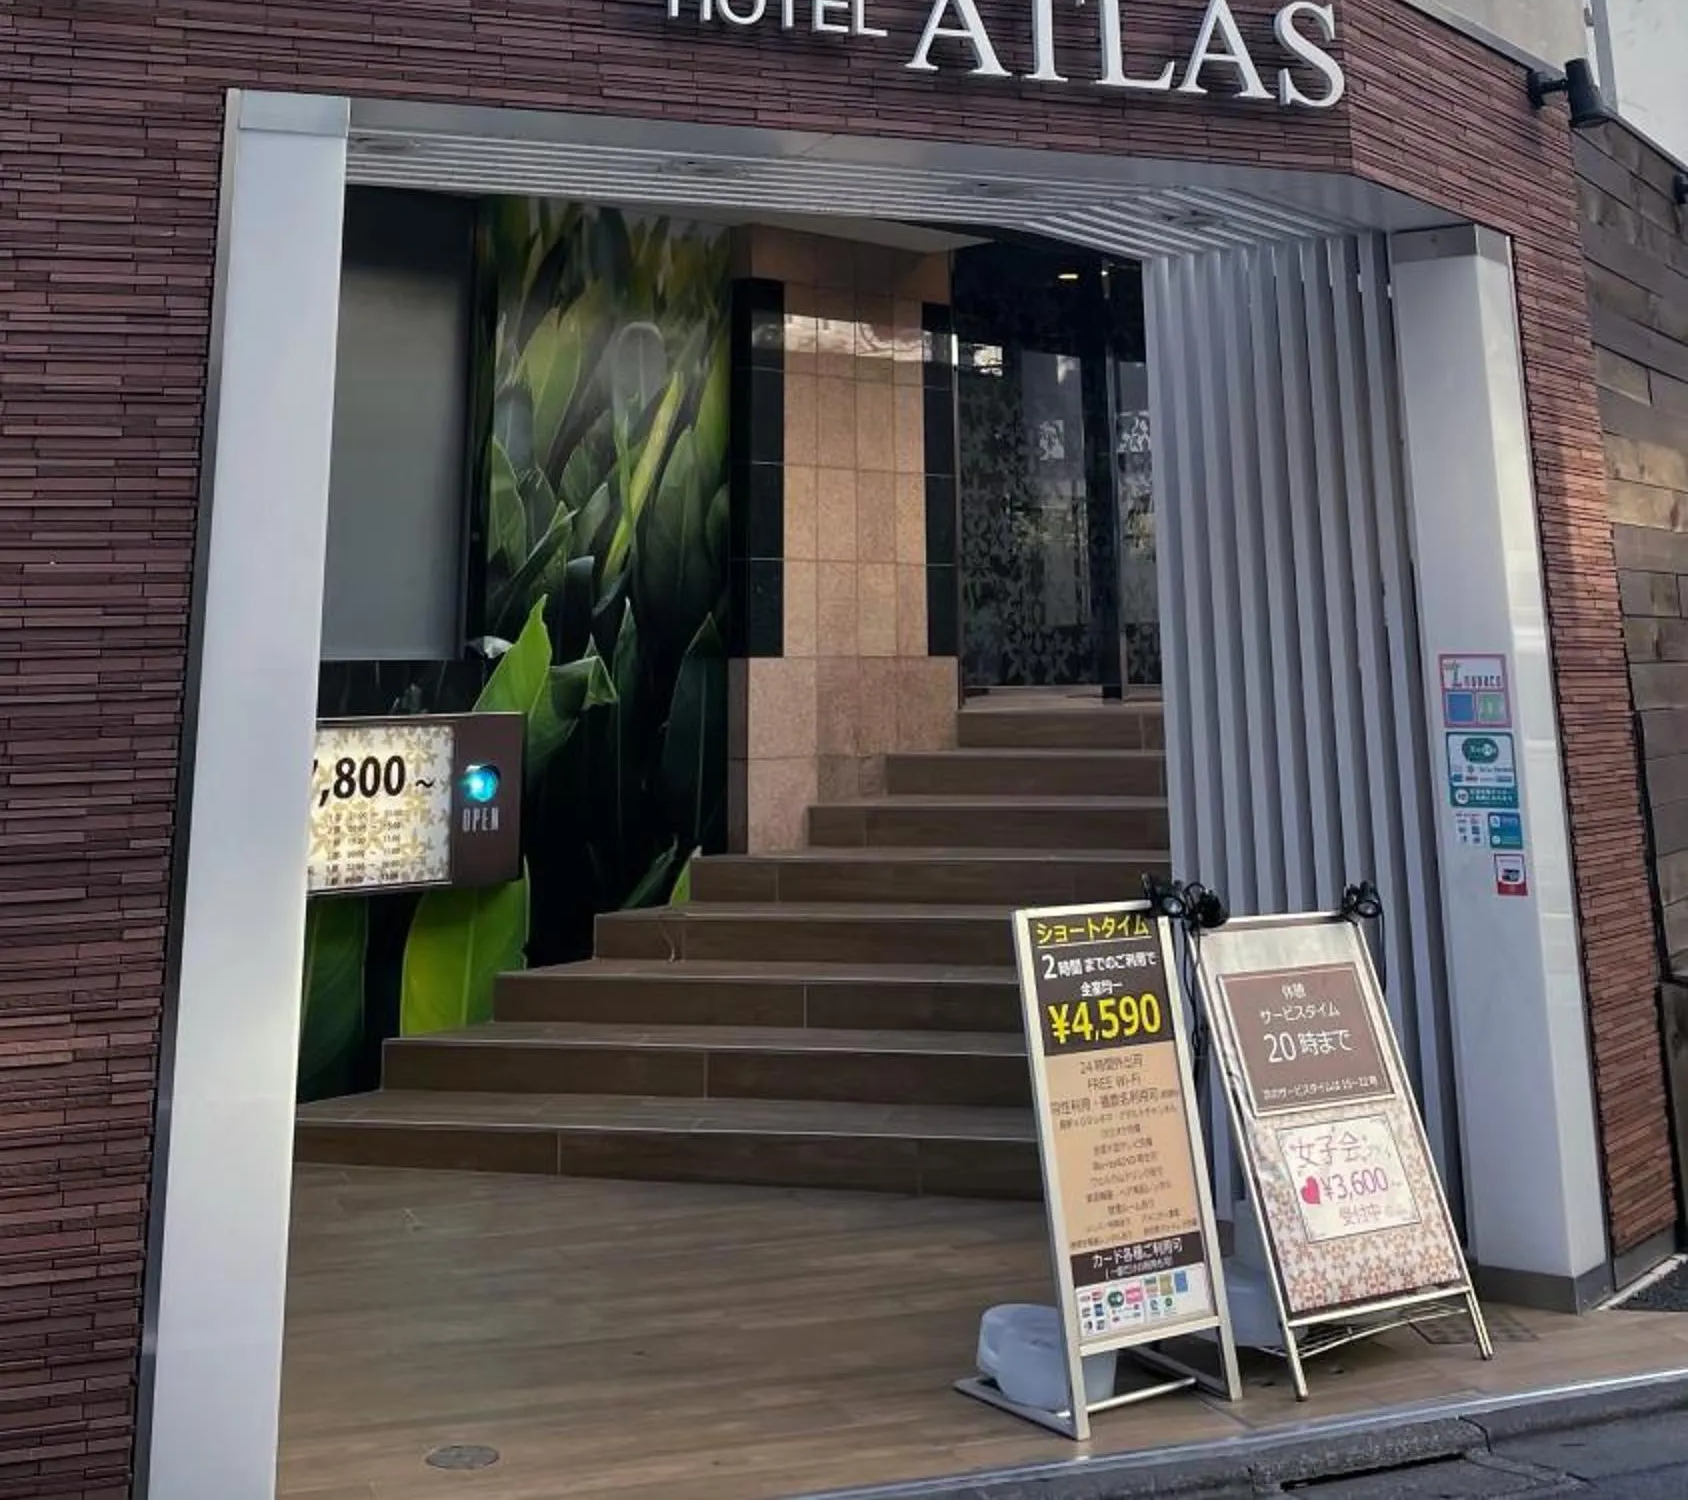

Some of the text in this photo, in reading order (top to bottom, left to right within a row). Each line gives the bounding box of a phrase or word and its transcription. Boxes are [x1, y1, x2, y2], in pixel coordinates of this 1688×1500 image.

[462, 807, 500, 832] OPEN
[1036, 913, 1149, 944] ショートタイム
[1047, 993, 1161, 1044] ¥4,590
[1259, 1001, 1341, 1025] サービスタイム
[1320, 1166, 1389, 1202] ¥3,600
